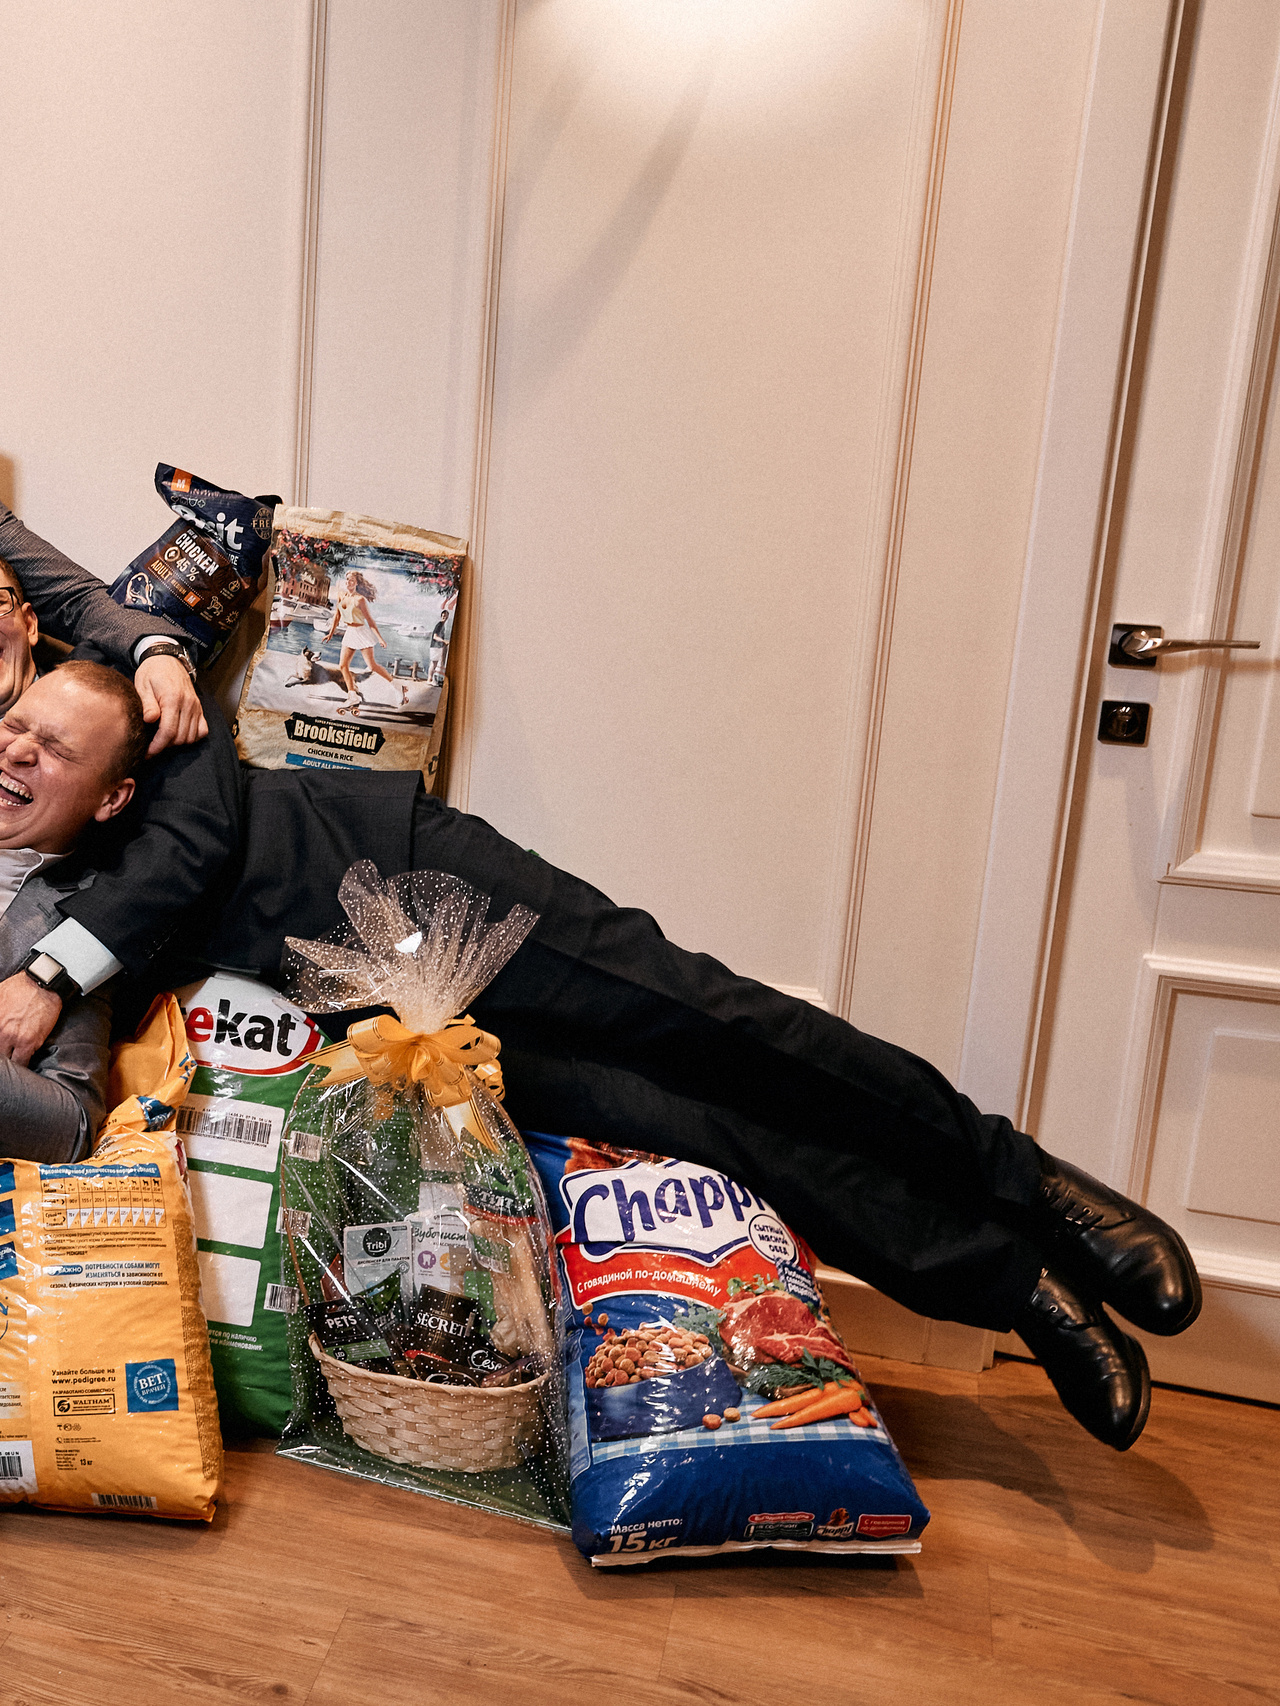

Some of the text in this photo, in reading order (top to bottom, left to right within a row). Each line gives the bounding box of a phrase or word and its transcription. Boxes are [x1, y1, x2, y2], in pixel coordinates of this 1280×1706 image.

[176, 479, 185, 489] M
[252, 519, 271, 528] FRE
[175, 532, 220, 577] CHICKEN
[176, 557, 200, 582] 45 %
[150, 559, 197, 605] ADULT MEDIUM M
[294, 720, 378, 750] Brooksfield
[307, 748, 334, 759] CHICKEN
[339, 753, 354, 762] RICE
[303, 759, 332, 770] ADULT ALL
[184, 998, 296, 1057] ekat
[85, 1262, 124, 1270] ПОТРЕБНОСТИ
[68, 1281, 96, 1289] физических
[577, 1268, 721, 1297] С говядиной по-домашнему
[326, 1315, 358, 1329] PETS
[51, 1376, 116, 1385] www.pedigree.ru
[138, 1373, 166, 1390] ВЕТ.
[141, 1384, 166, 1396] ВРАЧЕЙ
[610, 1518, 683, 1535] Масса нетто:
[815, 1524, 853, 1536] Chappi
[610, 1531, 678, 1553] 15 кг
